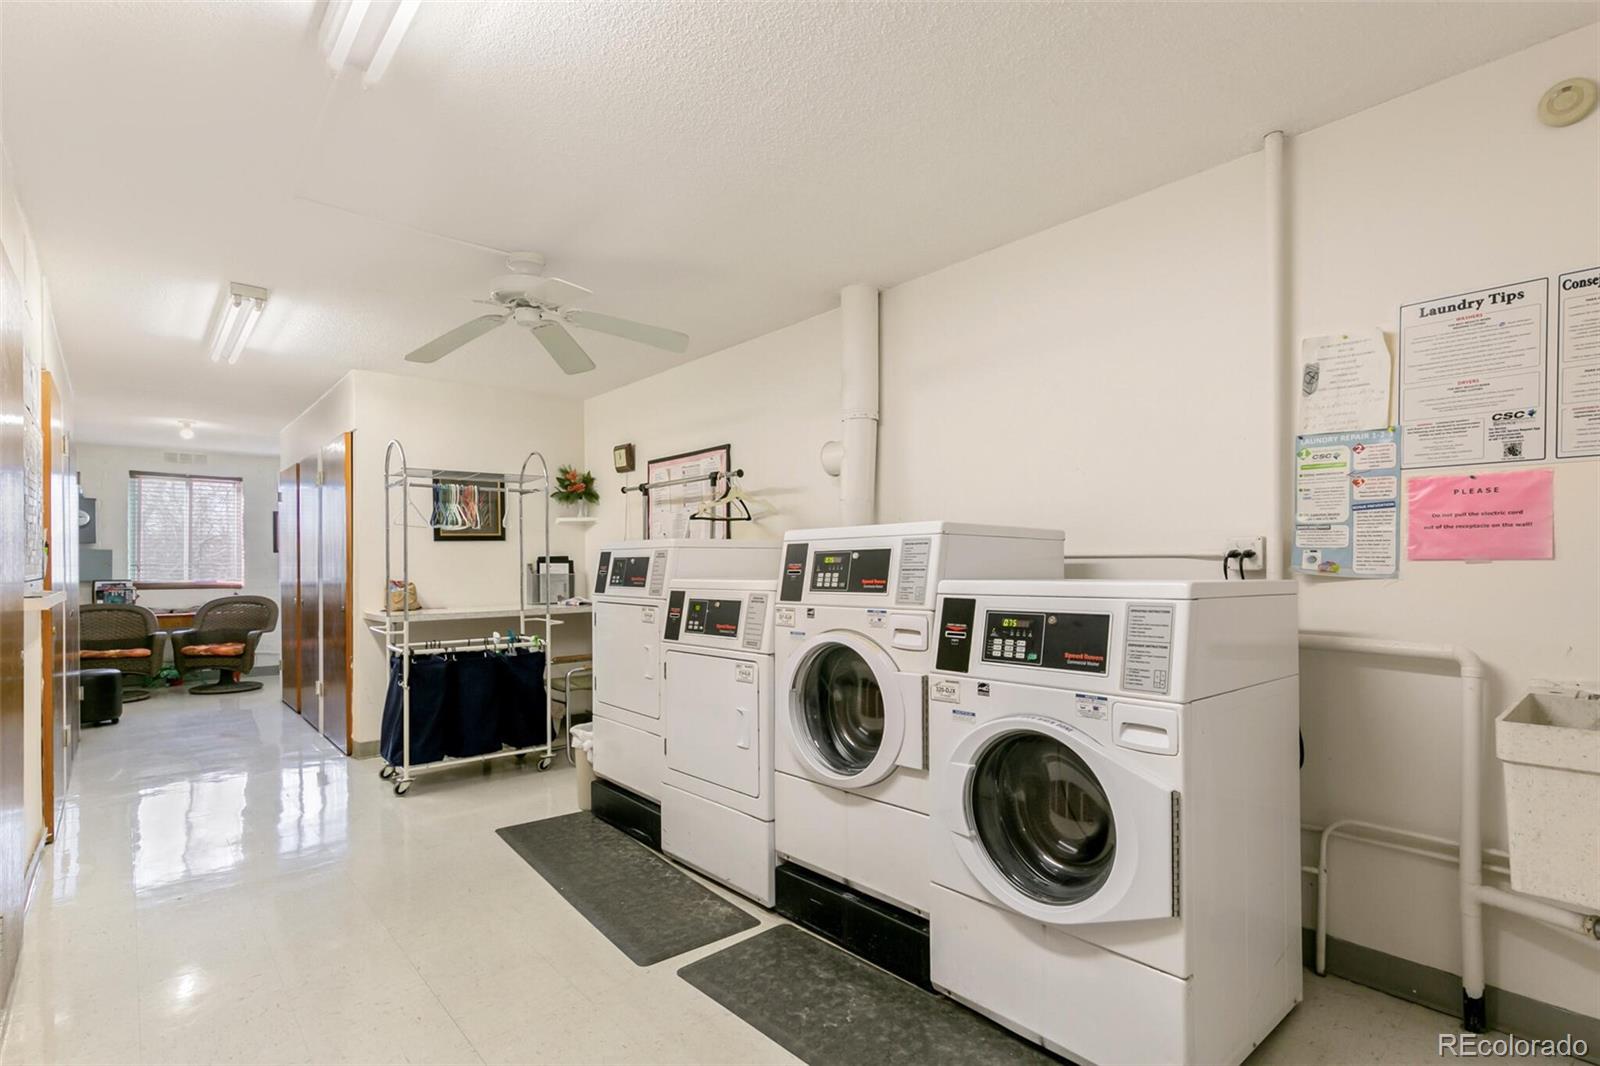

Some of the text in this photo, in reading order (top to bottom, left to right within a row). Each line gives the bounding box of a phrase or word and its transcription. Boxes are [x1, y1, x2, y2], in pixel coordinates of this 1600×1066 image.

[1419, 290, 1525, 318] Laundry Tips
[1492, 410, 1525, 421] CSC
[1300, 436, 1338, 445] LAUNDRY
[1340, 433, 1369, 442] REPAIR
[1454, 486, 1500, 495] PLEASE
